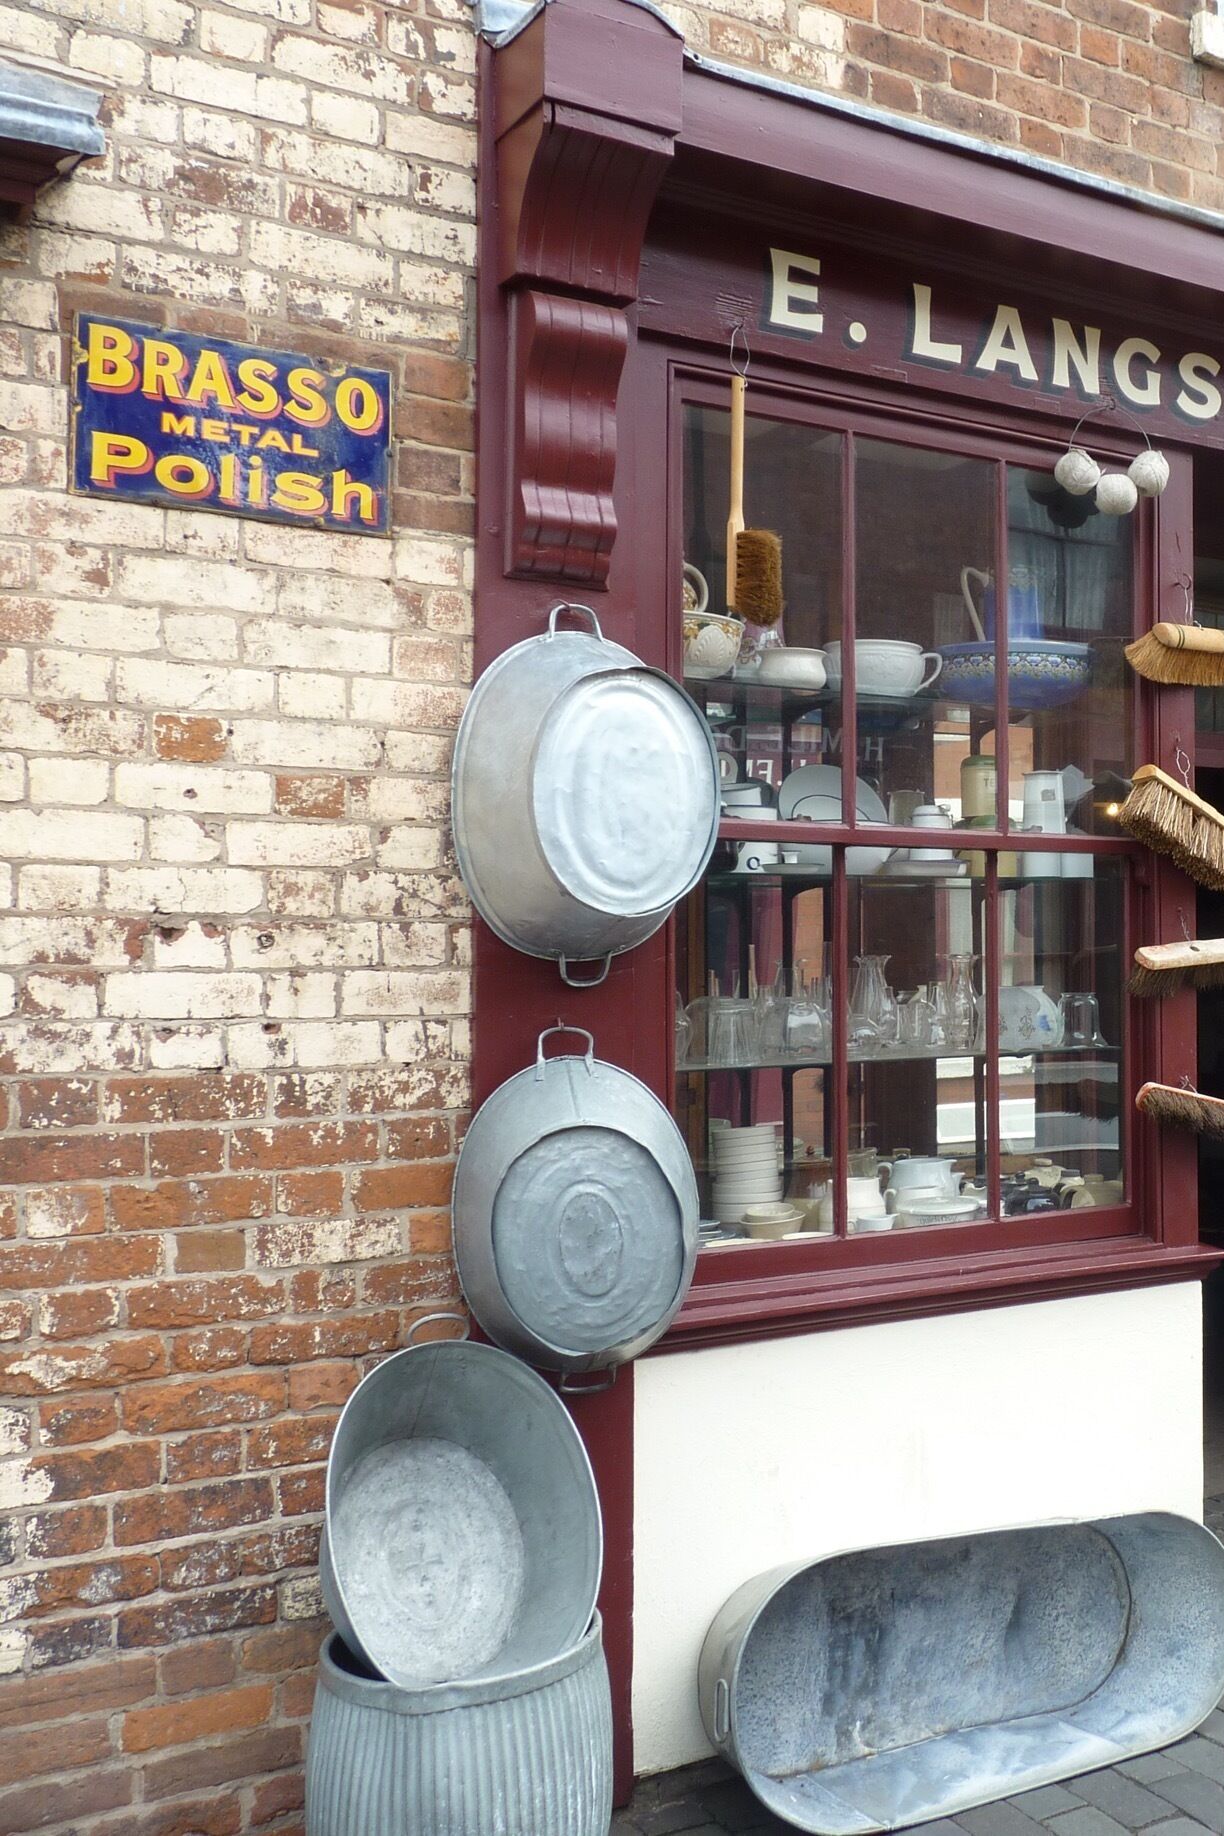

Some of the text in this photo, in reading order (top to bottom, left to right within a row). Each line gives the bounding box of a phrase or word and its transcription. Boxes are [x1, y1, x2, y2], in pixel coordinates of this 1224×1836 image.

[768, 247, 868, 344] E.
[86, 322, 382, 433] BRASSO
[90, 430, 378, 523] Polish
[161, 412, 320, 458] METAL
